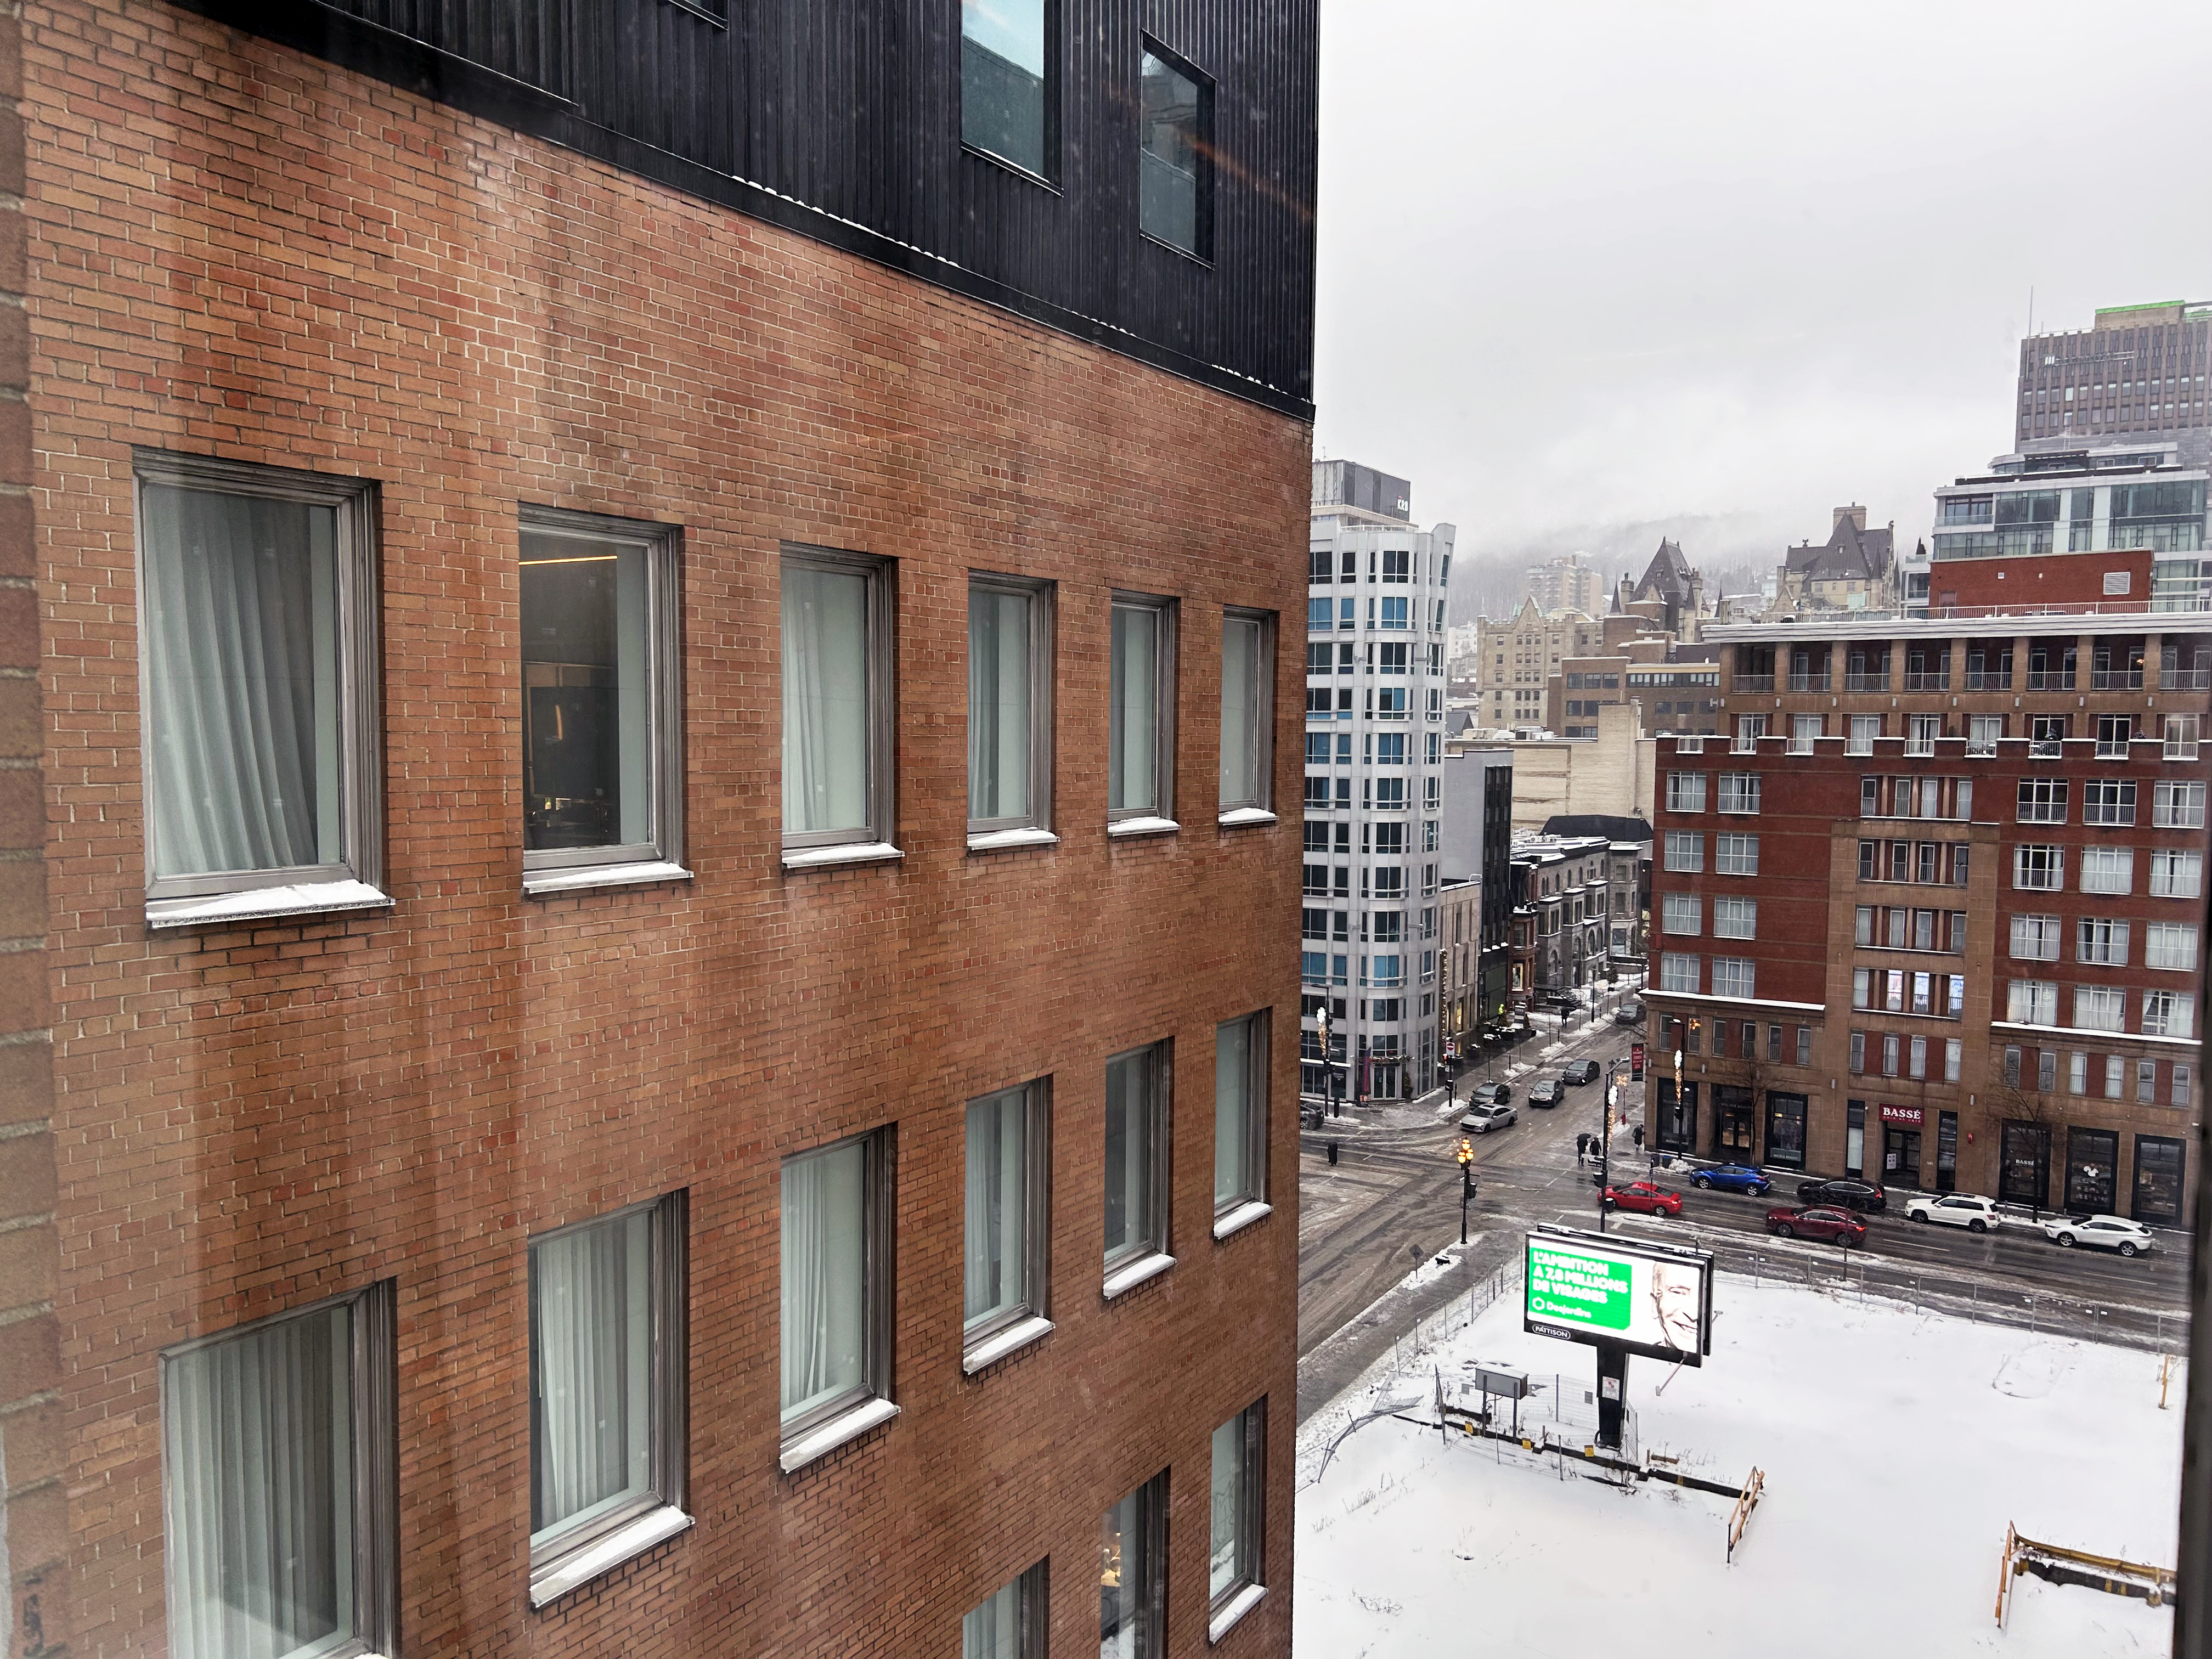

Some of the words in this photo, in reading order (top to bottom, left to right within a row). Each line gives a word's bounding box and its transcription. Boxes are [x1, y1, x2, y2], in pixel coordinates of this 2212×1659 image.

[1397, 499, 1408, 511] KRB
[1883, 1107, 1921, 1119] BASSÉ
[1565, 1270, 1628, 1294] MILLIONS
[1533, 1278, 1550, 1293] DE
[1551, 1282, 1608, 1304] VISAGES
[1546, 1301, 1592, 1318] Desjardins
